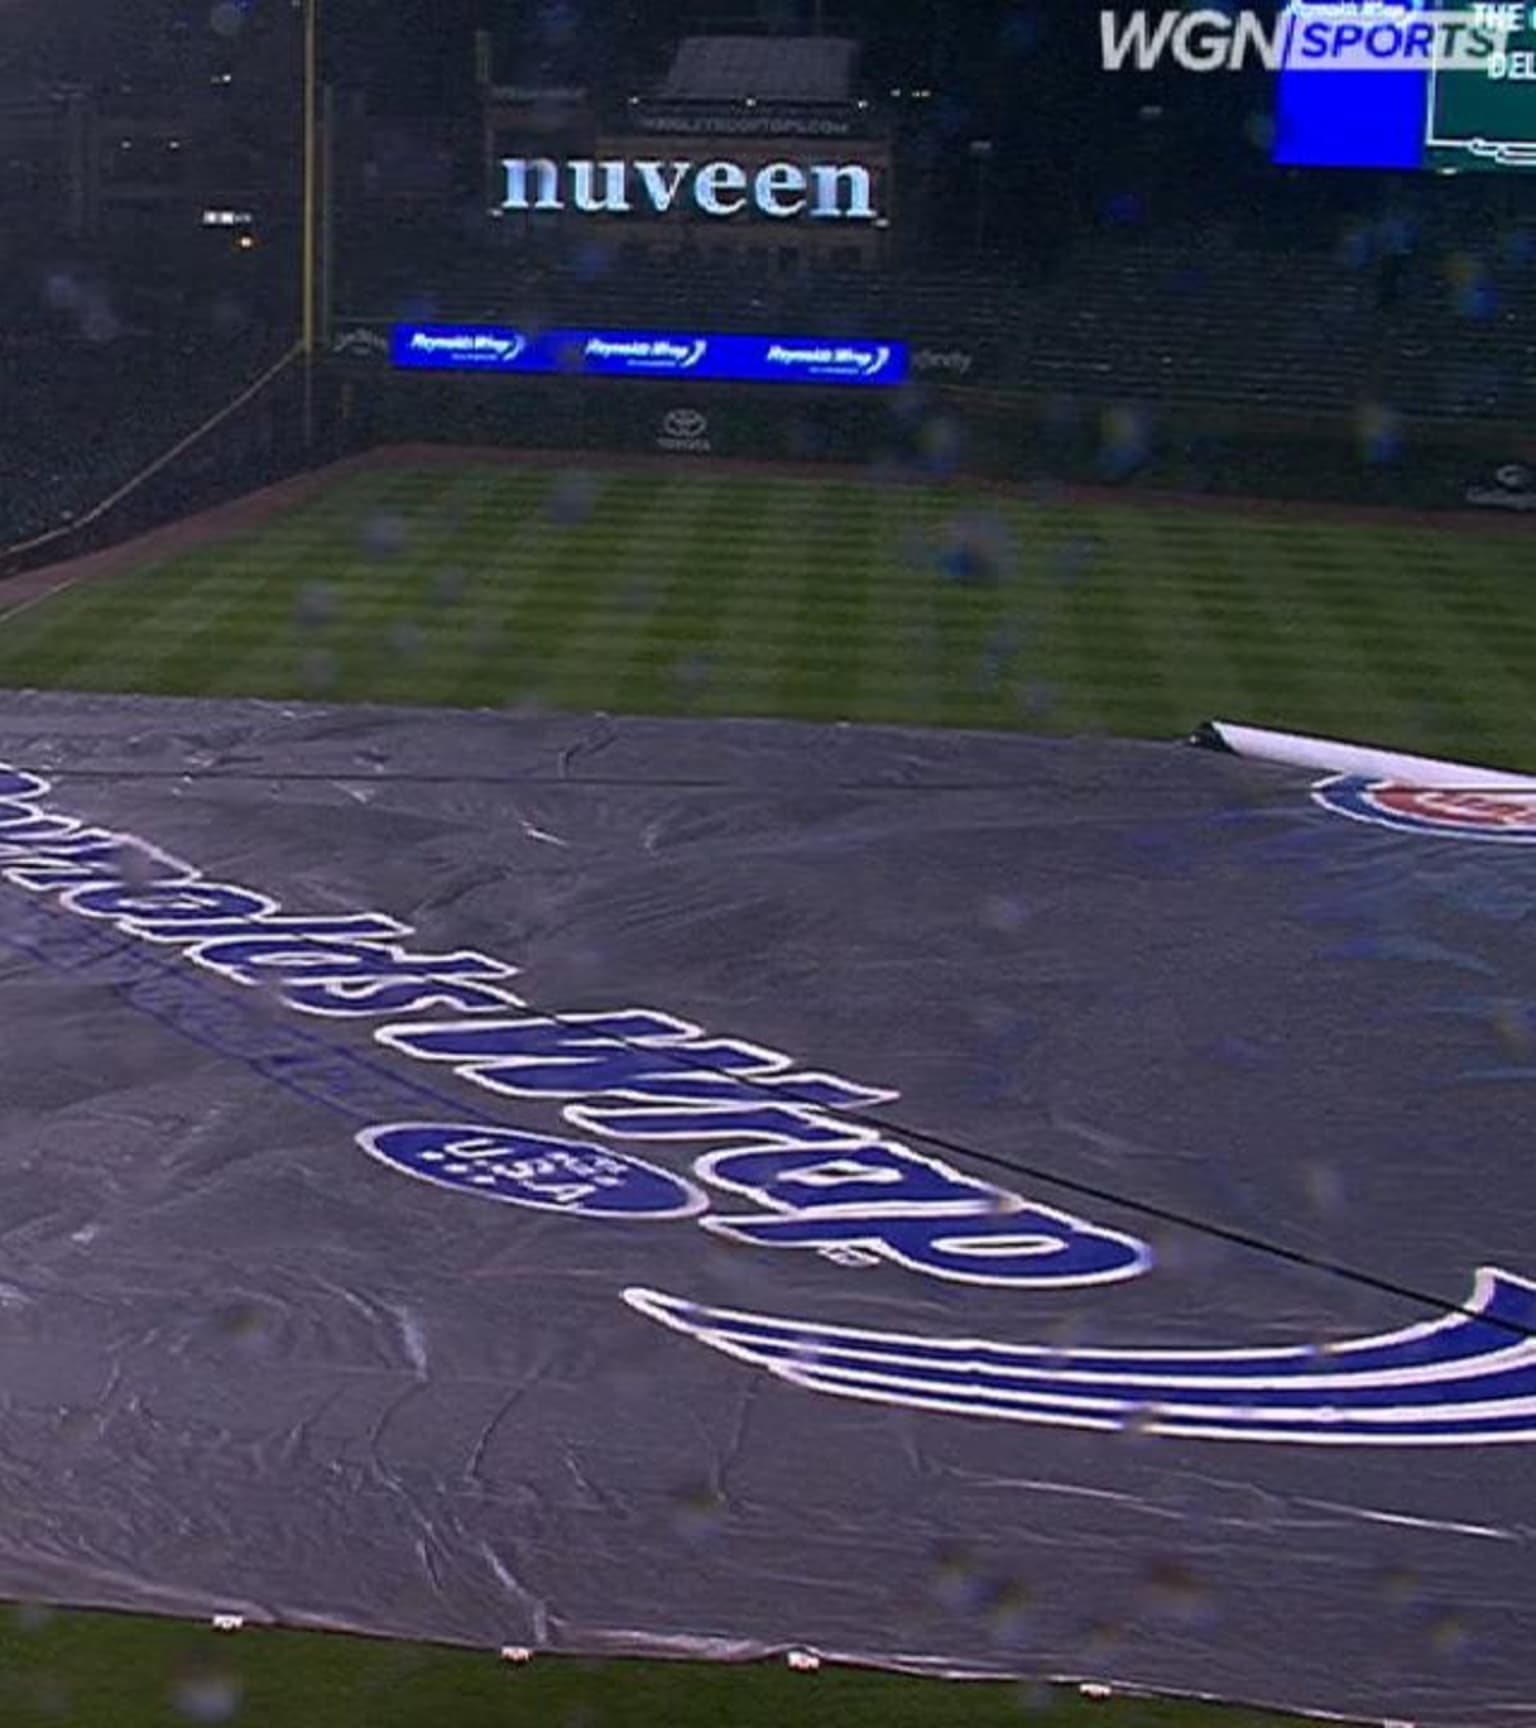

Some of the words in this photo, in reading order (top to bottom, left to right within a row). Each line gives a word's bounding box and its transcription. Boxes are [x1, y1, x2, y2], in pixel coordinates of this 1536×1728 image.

[1474, 3, 1525, 31] THE
[501, 158, 878, 217] nuveen
[372, 1010, 1154, 1288] Wrap
